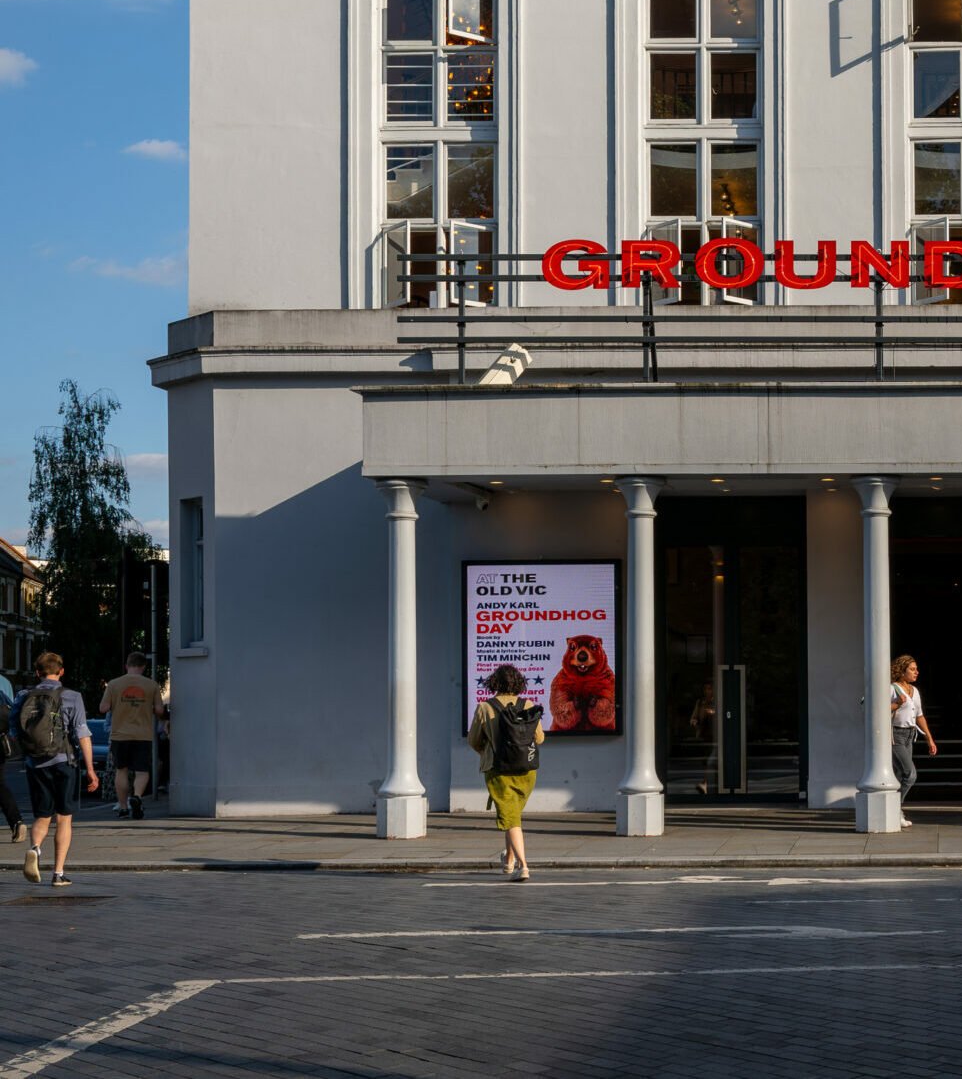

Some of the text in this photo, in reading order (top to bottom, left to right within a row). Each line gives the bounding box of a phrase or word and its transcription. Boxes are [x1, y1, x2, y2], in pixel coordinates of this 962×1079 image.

[476, 573, 537, 584] AT THE
[476, 585, 547, 596] OLD VIC
[476, 602, 508, 610] ANDY
[476, 610, 606, 621] GROUNDHOG
[476, 623, 514, 634] DAY
[476, 640, 517, 648] DANNY
[477, 653, 551, 662] TIM MINCHIN
